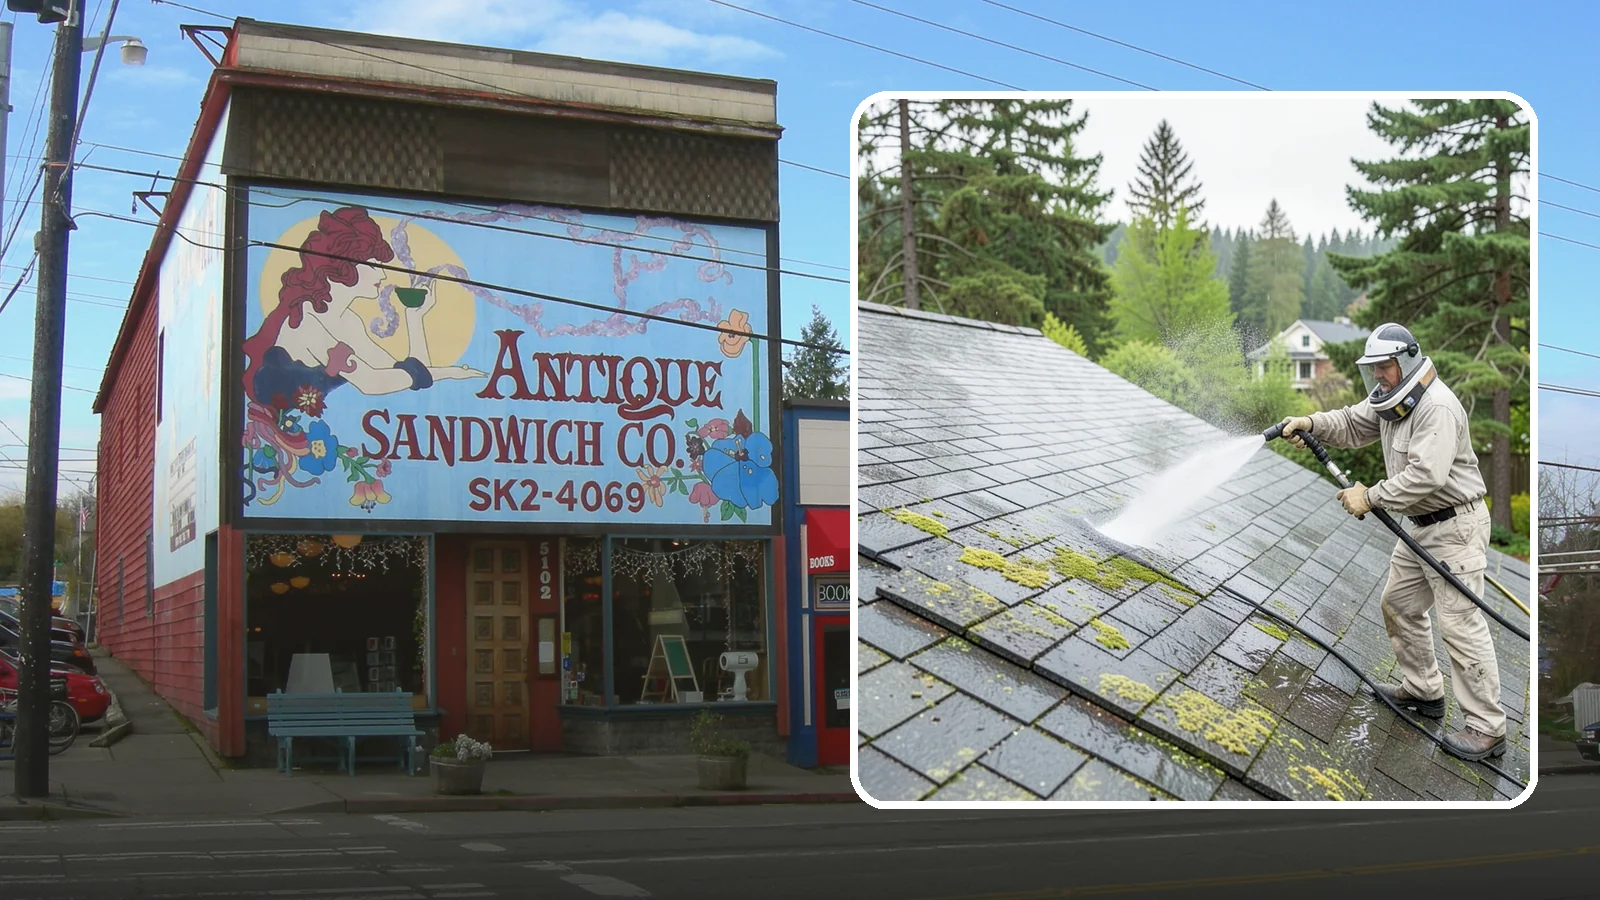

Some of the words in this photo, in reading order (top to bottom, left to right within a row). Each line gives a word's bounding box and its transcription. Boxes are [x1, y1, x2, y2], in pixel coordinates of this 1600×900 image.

[476, 329, 723, 421] ANTIQUE
[361, 408, 605, 467] SANDWICH
[617, 422, 685, 469] CO.
[468, 477, 646, 513] SK2-4069
[540, 541, 552, 600] 5102
[809, 555, 835, 569] BOOKS
